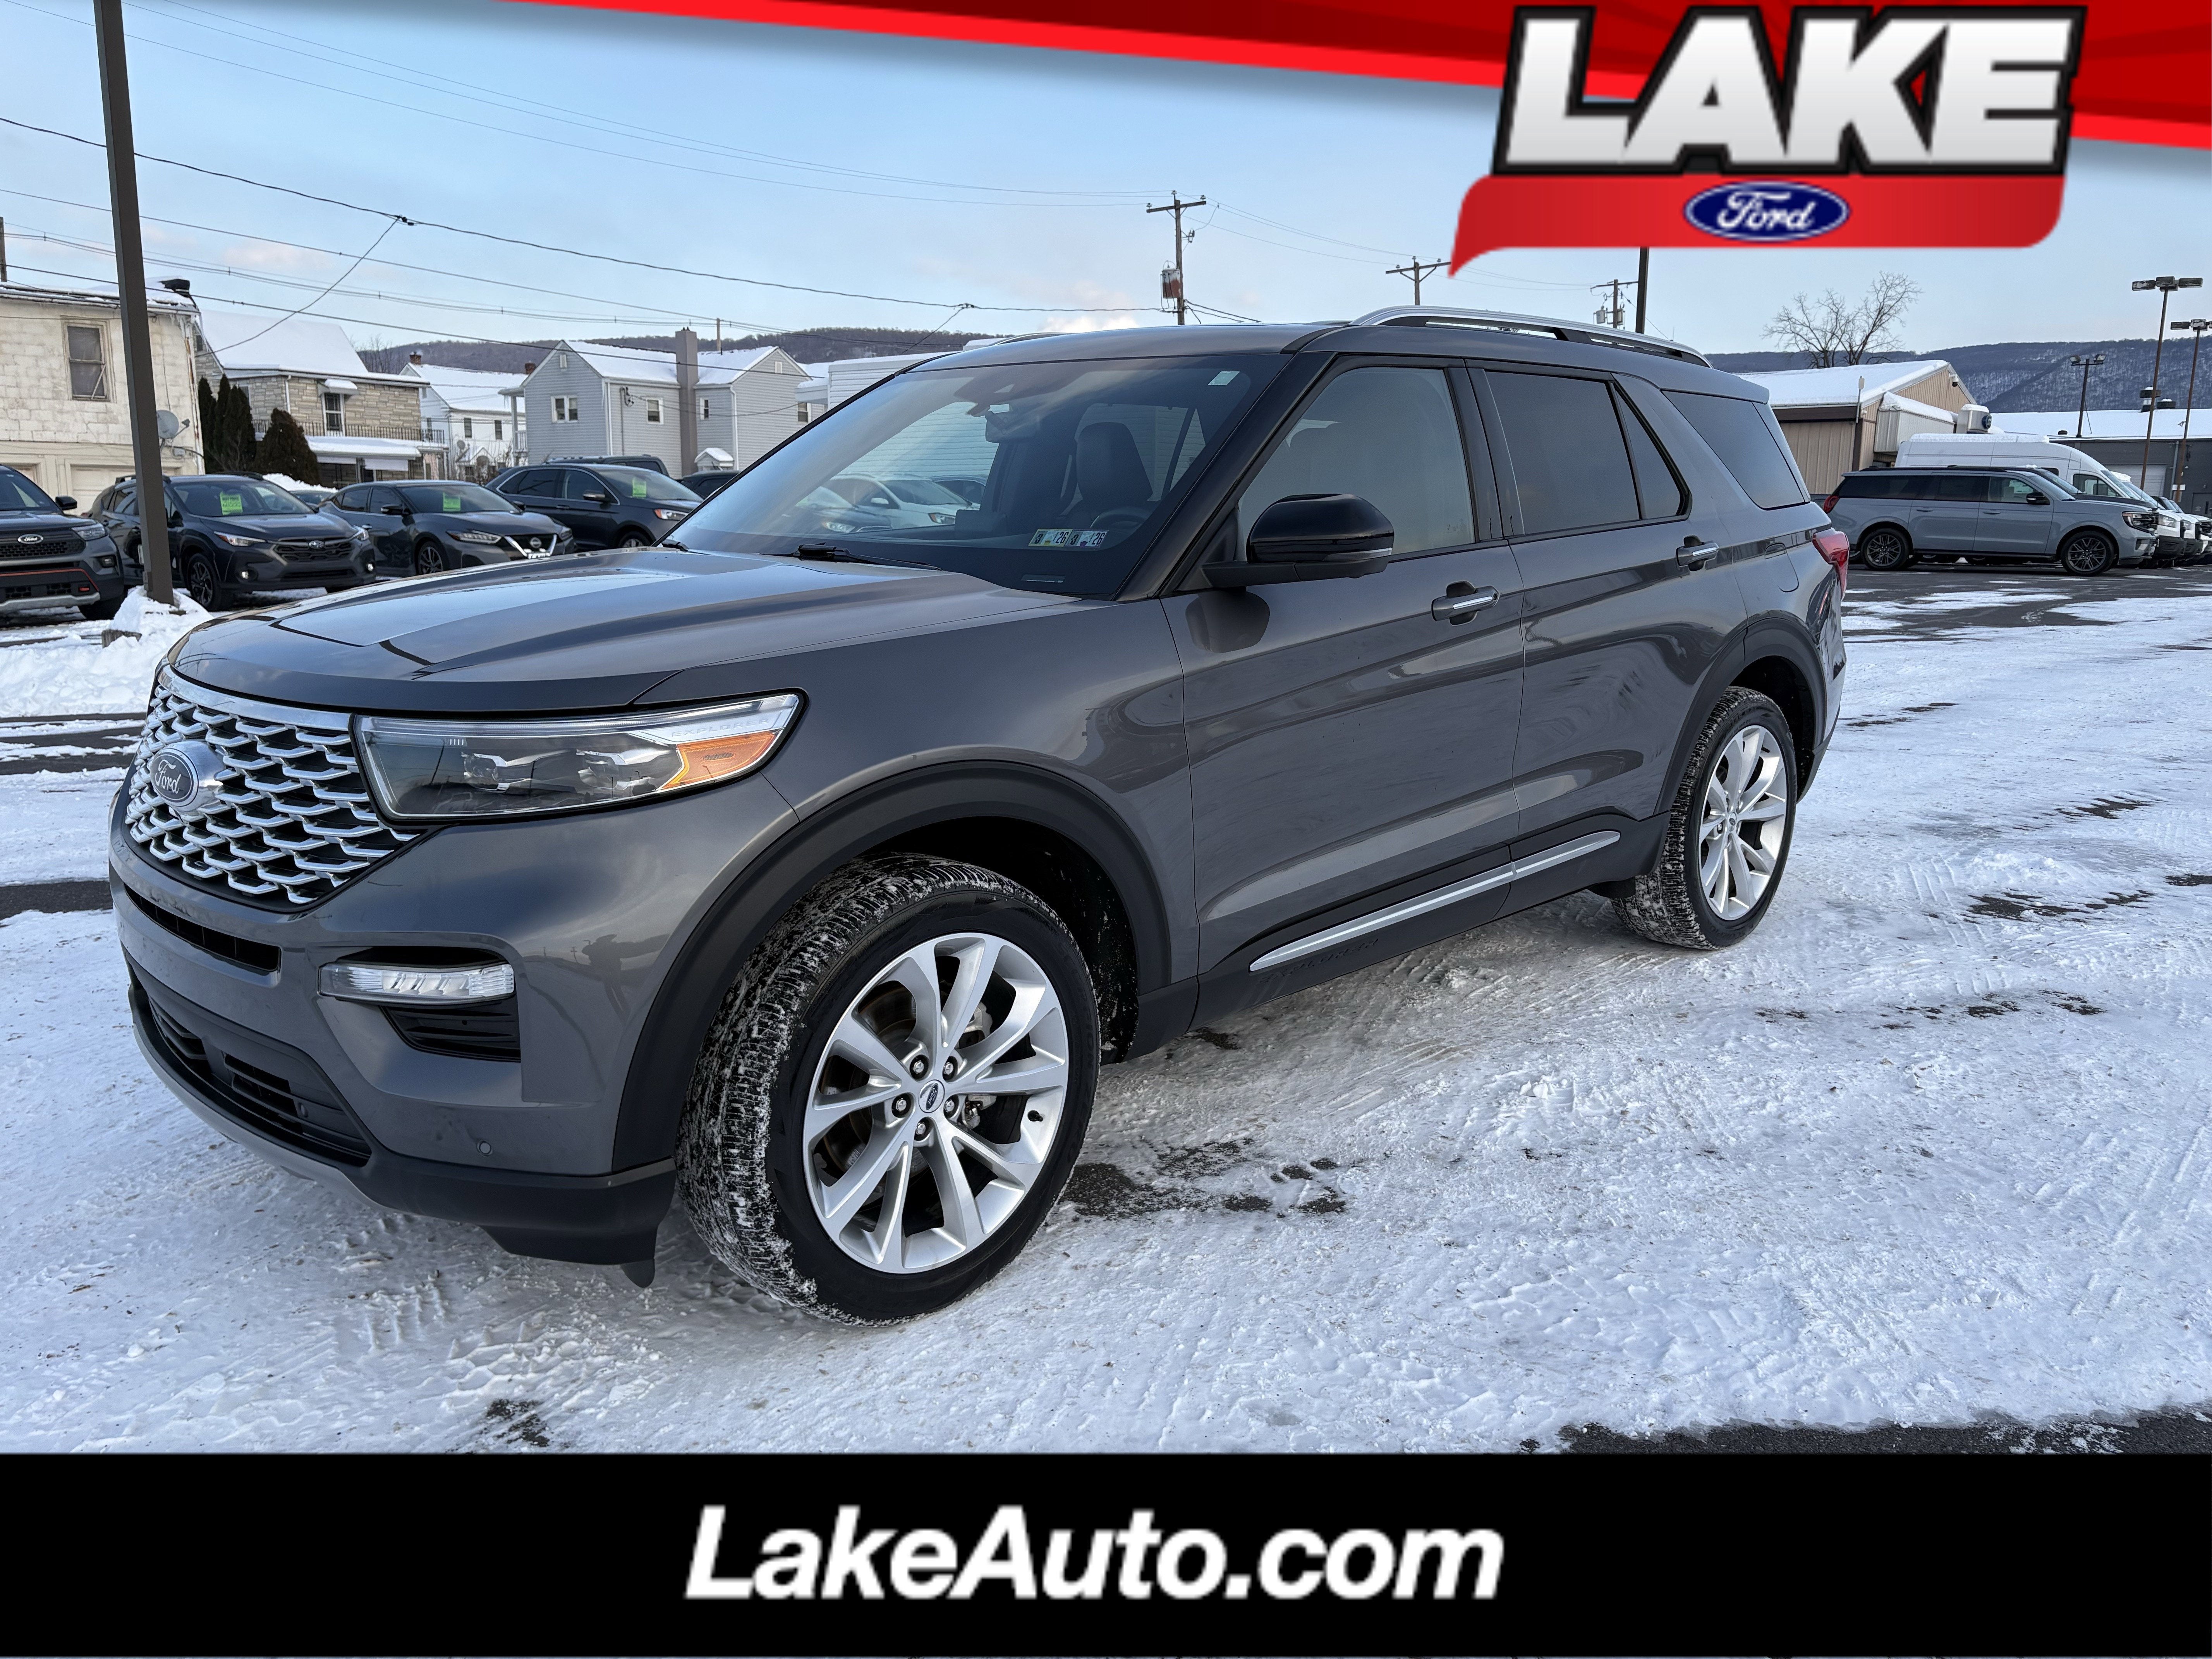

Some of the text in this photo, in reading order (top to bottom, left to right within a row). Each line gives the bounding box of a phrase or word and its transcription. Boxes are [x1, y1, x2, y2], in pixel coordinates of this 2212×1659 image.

[1034, 531, 1069, 544] 3 26
[1070, 532, 1105, 545] 3 26
[672, 718, 769, 737] EXPLORER
[155, 759, 181, 794] Ford
[1259, 938, 1379, 984] EXPLORER
